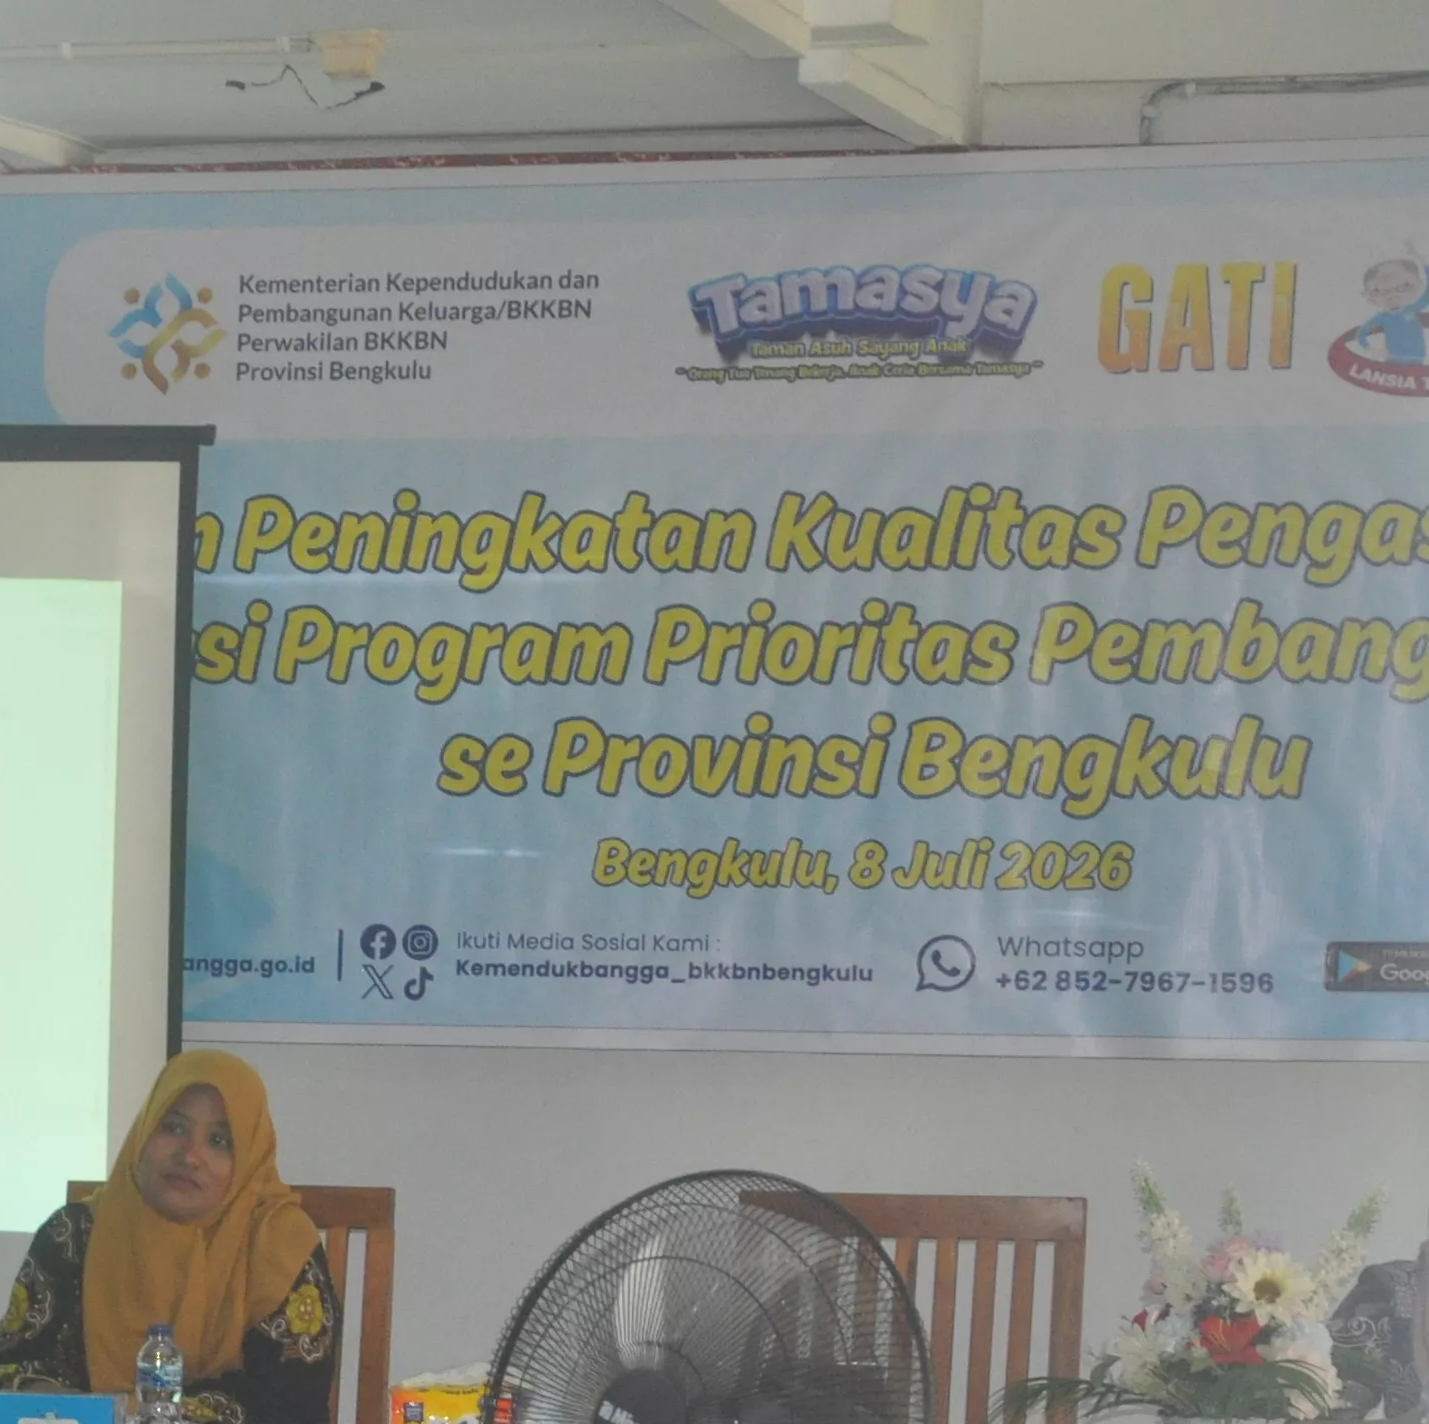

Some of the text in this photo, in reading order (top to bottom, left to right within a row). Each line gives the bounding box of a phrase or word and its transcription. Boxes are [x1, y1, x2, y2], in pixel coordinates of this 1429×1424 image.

[238, 269, 600, 298] Kementerian Kependudukan dan
[237, 298, 593, 328] Pembangunan Keluarga/BKKBN
[690, 264, 1037, 346] Tamasya
[1097, 260, 1297, 375] GATI
[237, 330, 448, 353] Perwakilan BKKBN
[808, 339, 853, 358] Asuh
[856, 338, 921, 361] Sayang
[924, 336, 968, 355] Anak
[236, 360, 432, 385] Provinsi Bengkulu
[1348, 363, 1417, 390] LANSIA
[233, 488, 756, 594] Peningkatan
[766, 483, 1127, 575] Kualitas
[1137, 485, 1429, 588] Penga
[192, 598, 273, 685] si
[273, 604, 633, 706] Program
[642, 599, 1020, 686] Prioritas
[435, 711, 1313, 820] se Provinsi Bengkulu
[591, 836, 1136, 900] Bengkulu, 8 Juli 2026
[455, 931, 501, 953] Ikuti
[507, 932, 574, 952] Media
[581, 933, 646, 953] Sosial
[651, 934, 710, 954] Kami
[997, 934, 1144, 966] Whatsapp
[455, 959, 873, 986] Kemendukbangga_bkkbnbengkulu
[996, 971, 1274, 994] +62 852-7967-1596
